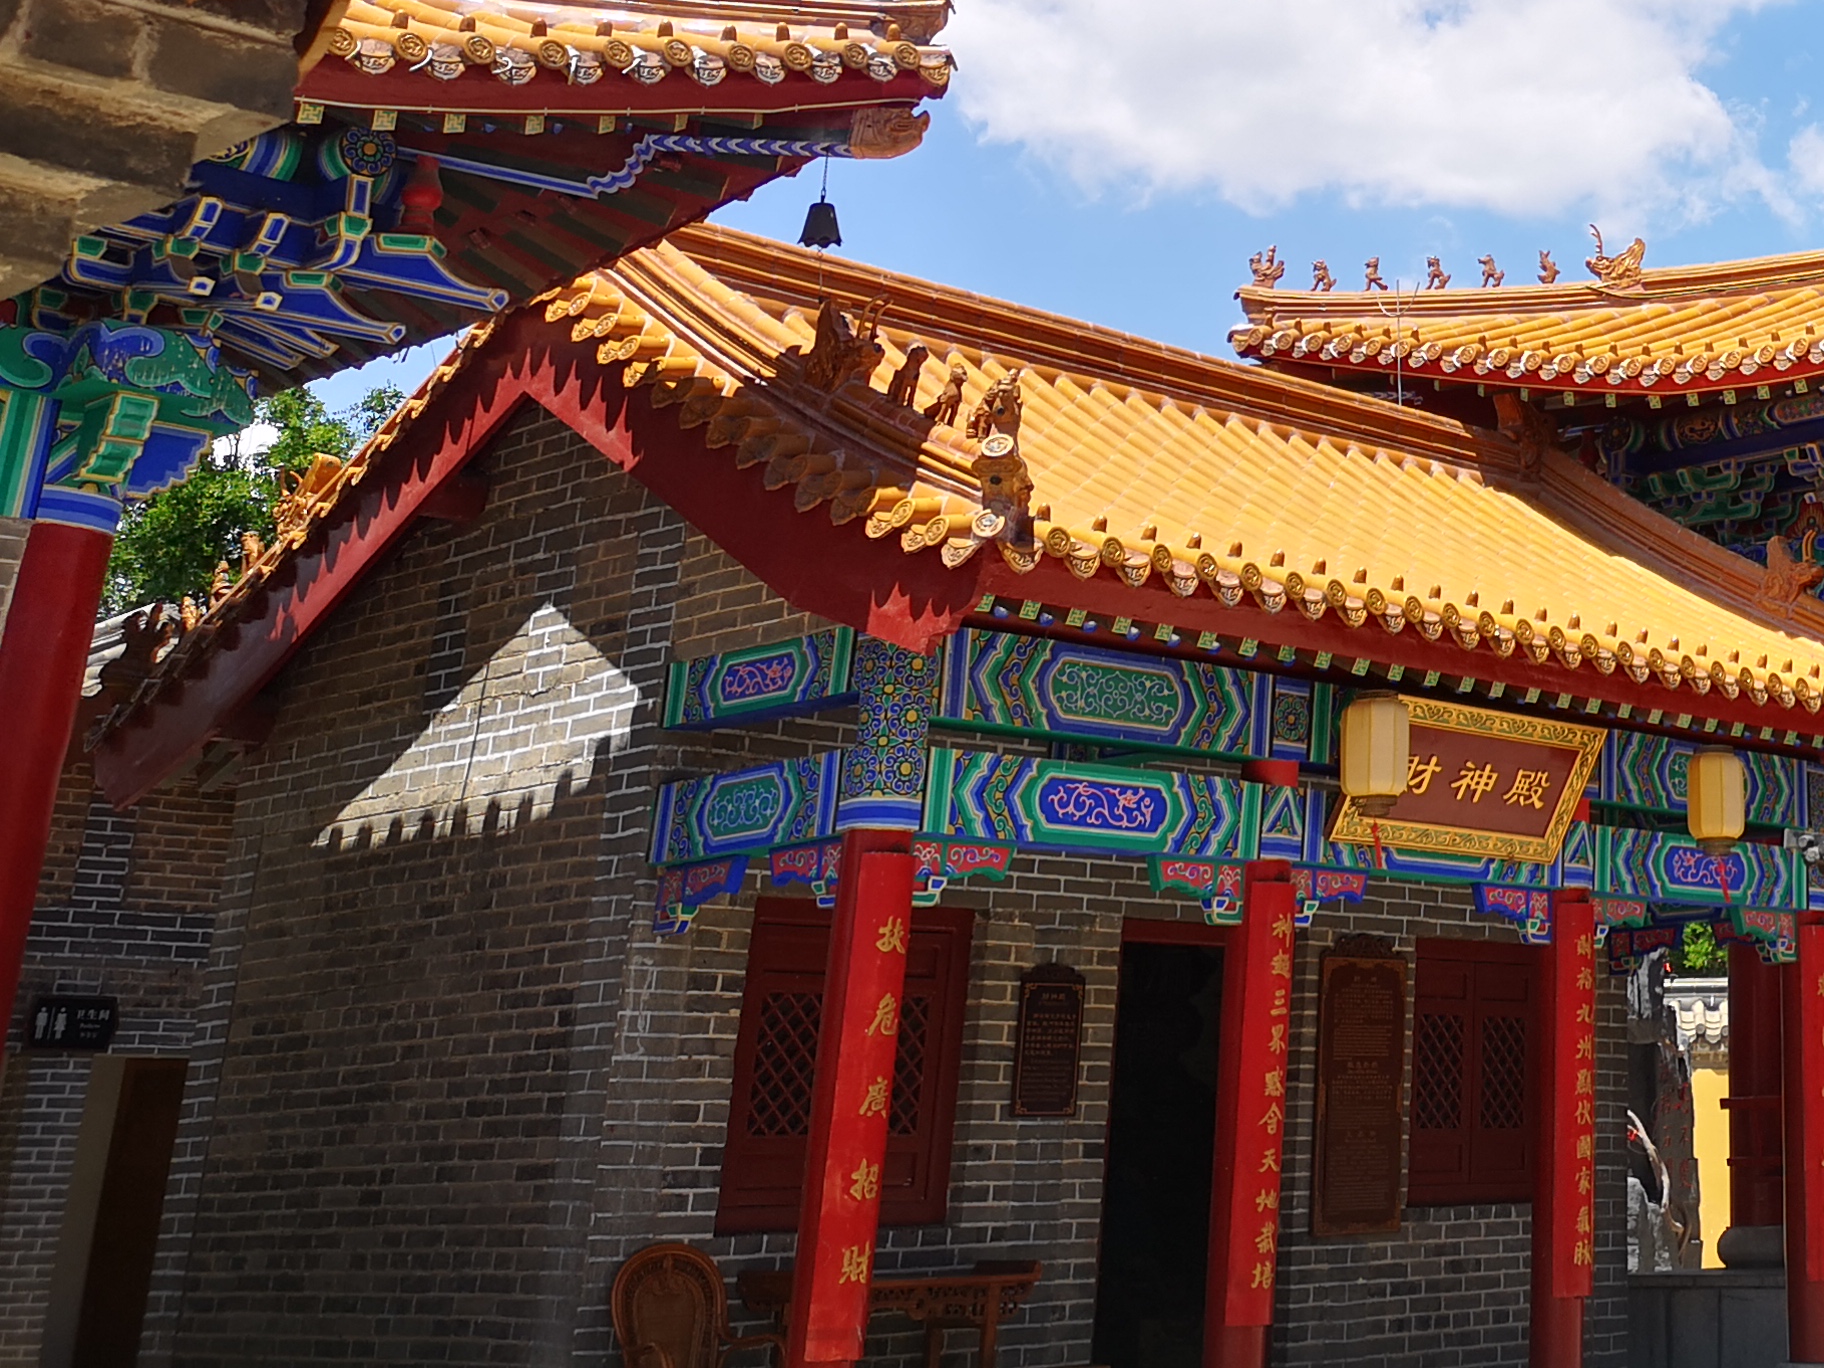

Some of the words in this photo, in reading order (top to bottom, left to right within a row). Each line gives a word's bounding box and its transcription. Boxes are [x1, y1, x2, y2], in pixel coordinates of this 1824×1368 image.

[1404, 753, 1551, 810] 財神殿
[77, 1009, 111, 1021] 卫生间
